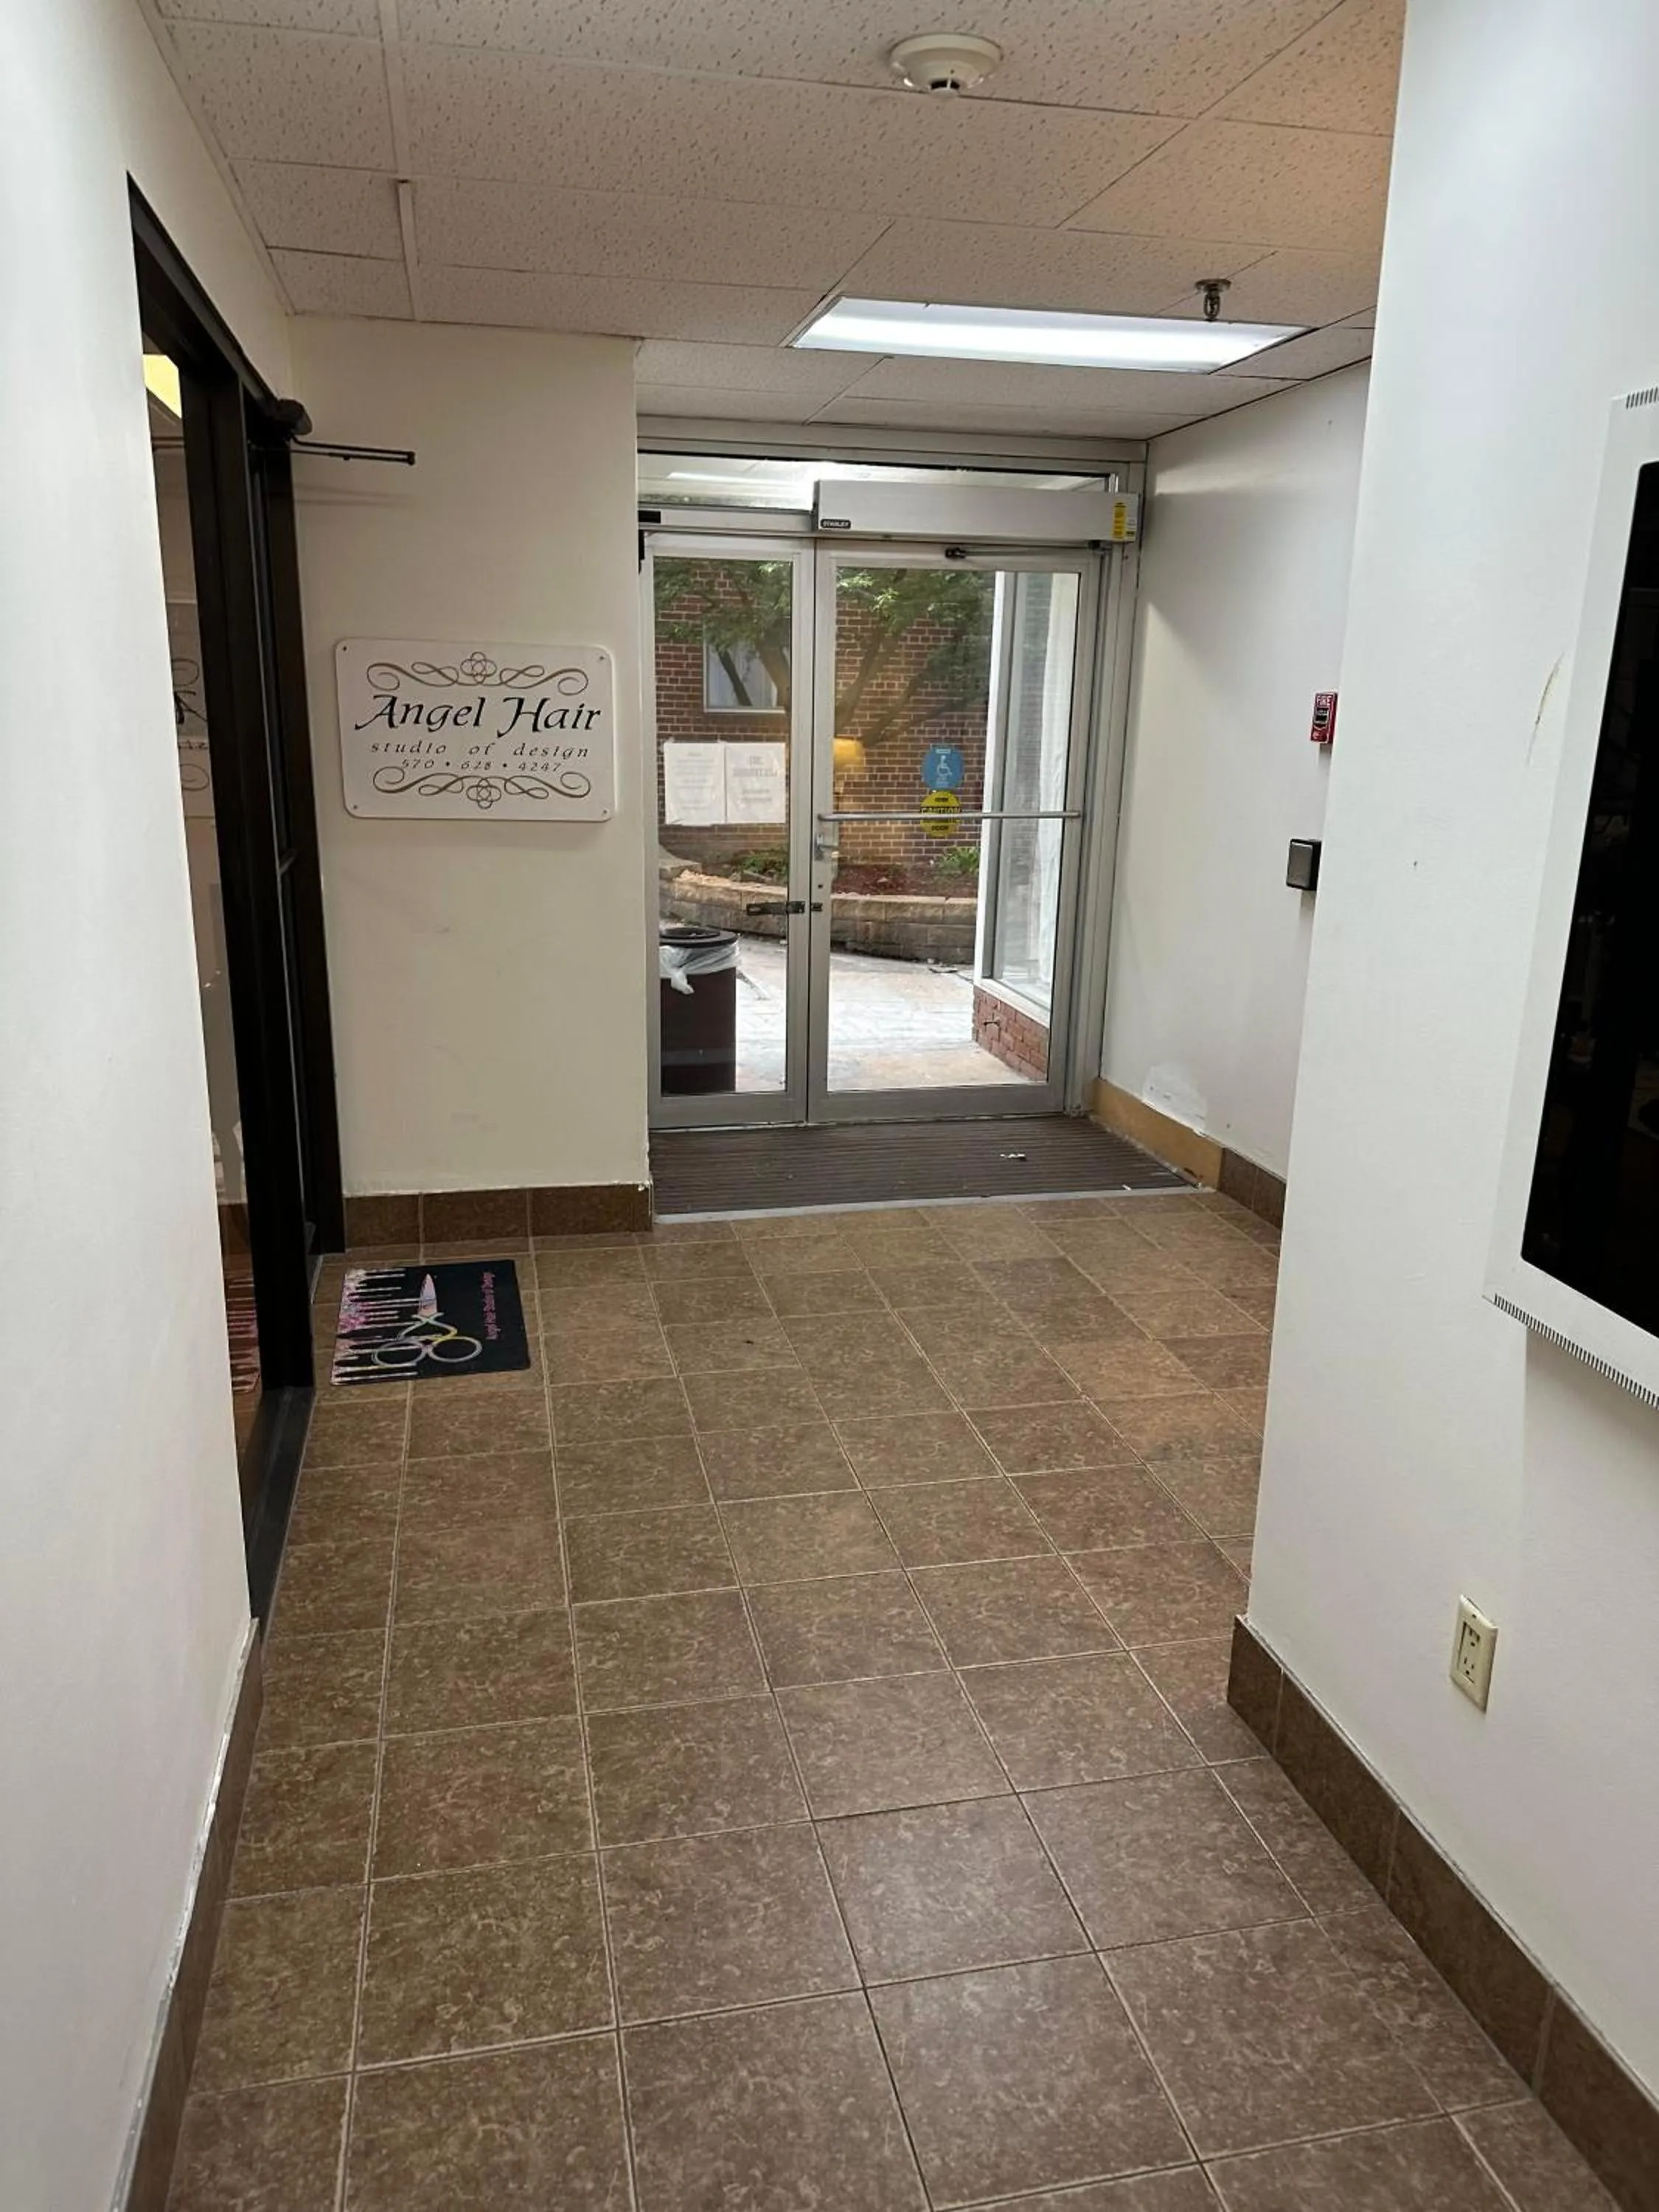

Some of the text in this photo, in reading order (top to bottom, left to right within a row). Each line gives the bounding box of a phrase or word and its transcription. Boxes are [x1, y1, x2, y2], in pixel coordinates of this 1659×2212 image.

[355, 695, 601, 738] Angel Hair
[370, 740, 588, 759] studio of design
